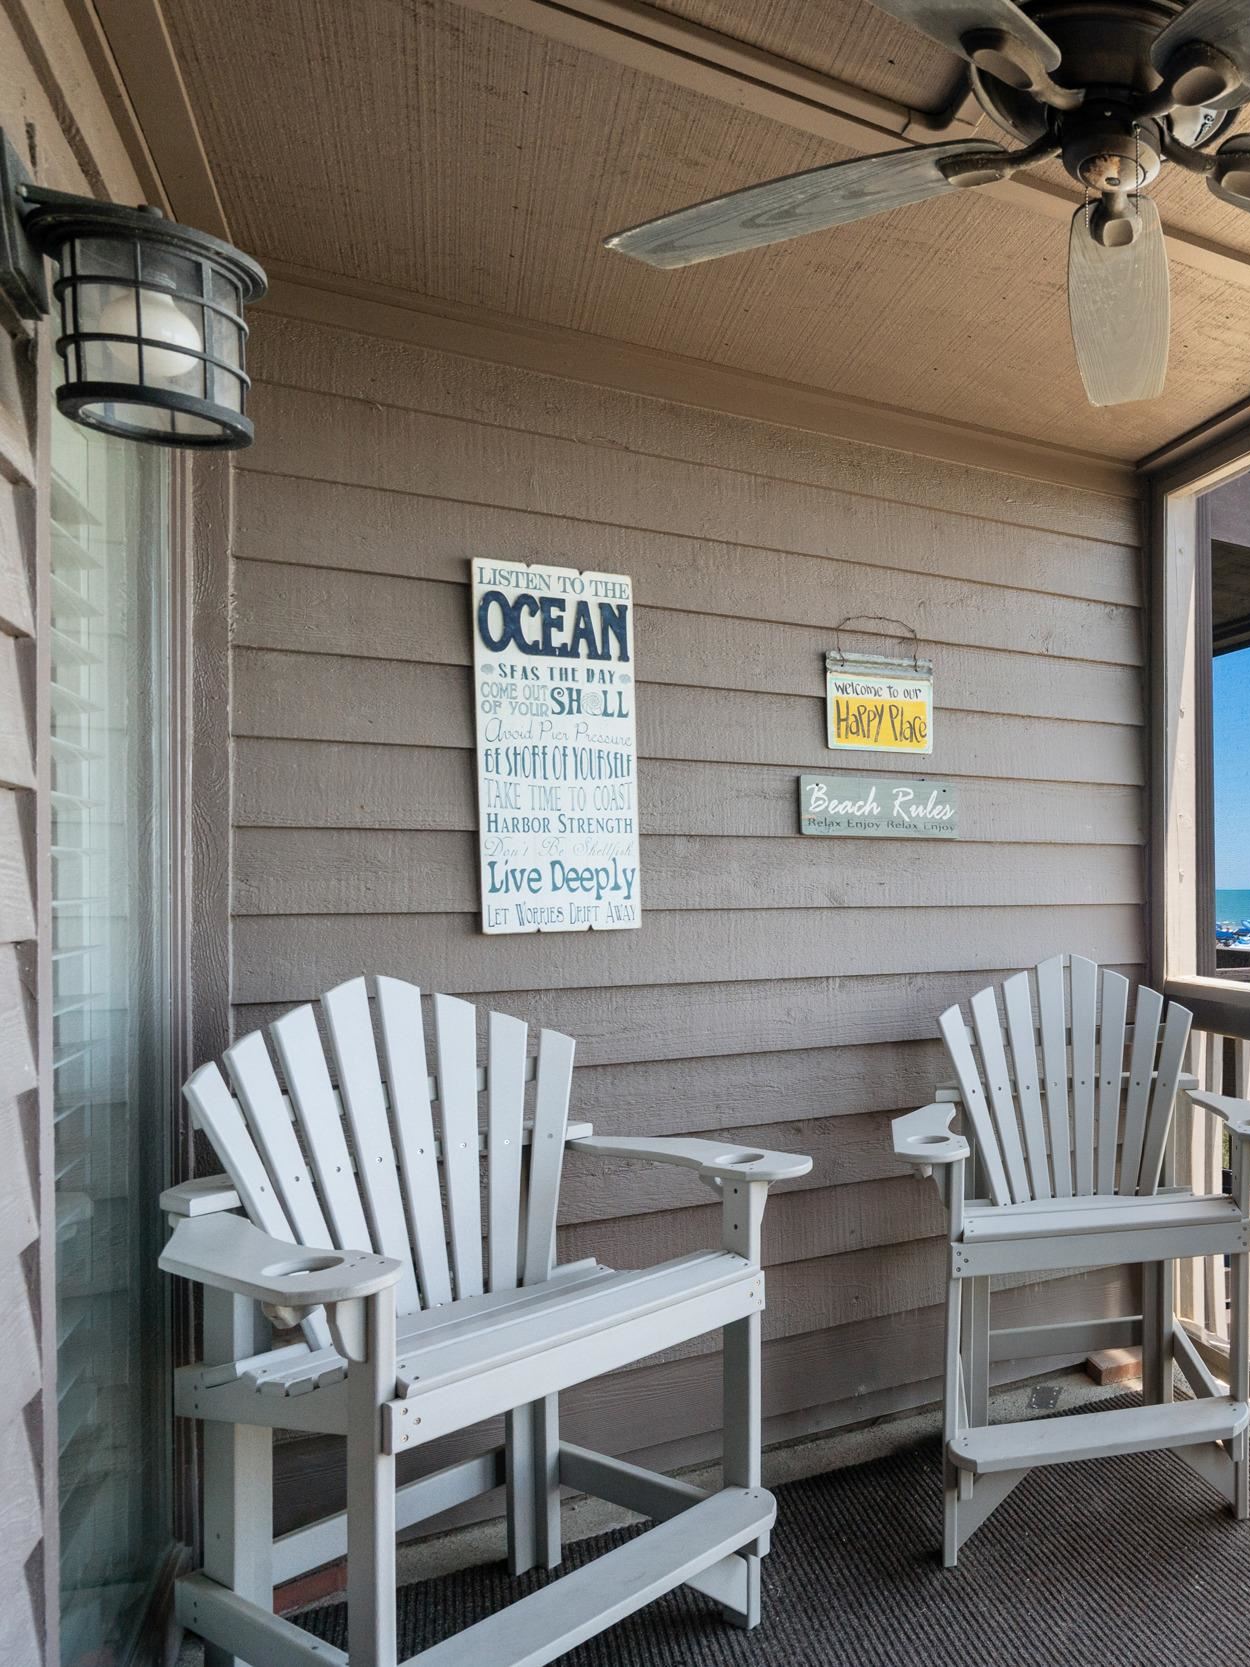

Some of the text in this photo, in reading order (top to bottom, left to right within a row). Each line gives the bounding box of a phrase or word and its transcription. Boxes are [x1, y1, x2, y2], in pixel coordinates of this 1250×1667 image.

[478, 566, 629, 599] LISTEN TO THE
[478, 590, 630, 662] OCEAN
[498, 662, 616, 684] SEAS THE DAY
[480, 682, 549, 701] COME OUT
[550, 687, 629, 719] SHLL
[887, 684, 899, 698] to
[903, 687, 922, 700] our
[481, 701, 549, 717] OF YOUR
[540, 719, 569, 742] Pier
[575, 721, 632, 747] Pressure
[484, 745, 632, 782] BE SHORE OF YOURSELF
[483, 777, 633, 811] TAKE TIME TO COAST
[806, 783, 955, 822] Beach Rules
[486, 812, 633, 834] HARBOR STRENGTH
[807, 817, 841, 828] Relax
[847, 818, 881, 830] Enjoy
[483, 836, 529, 857] Don't
[538, 836, 565, 857] Be
[487, 857, 636, 900] Live Deeply
